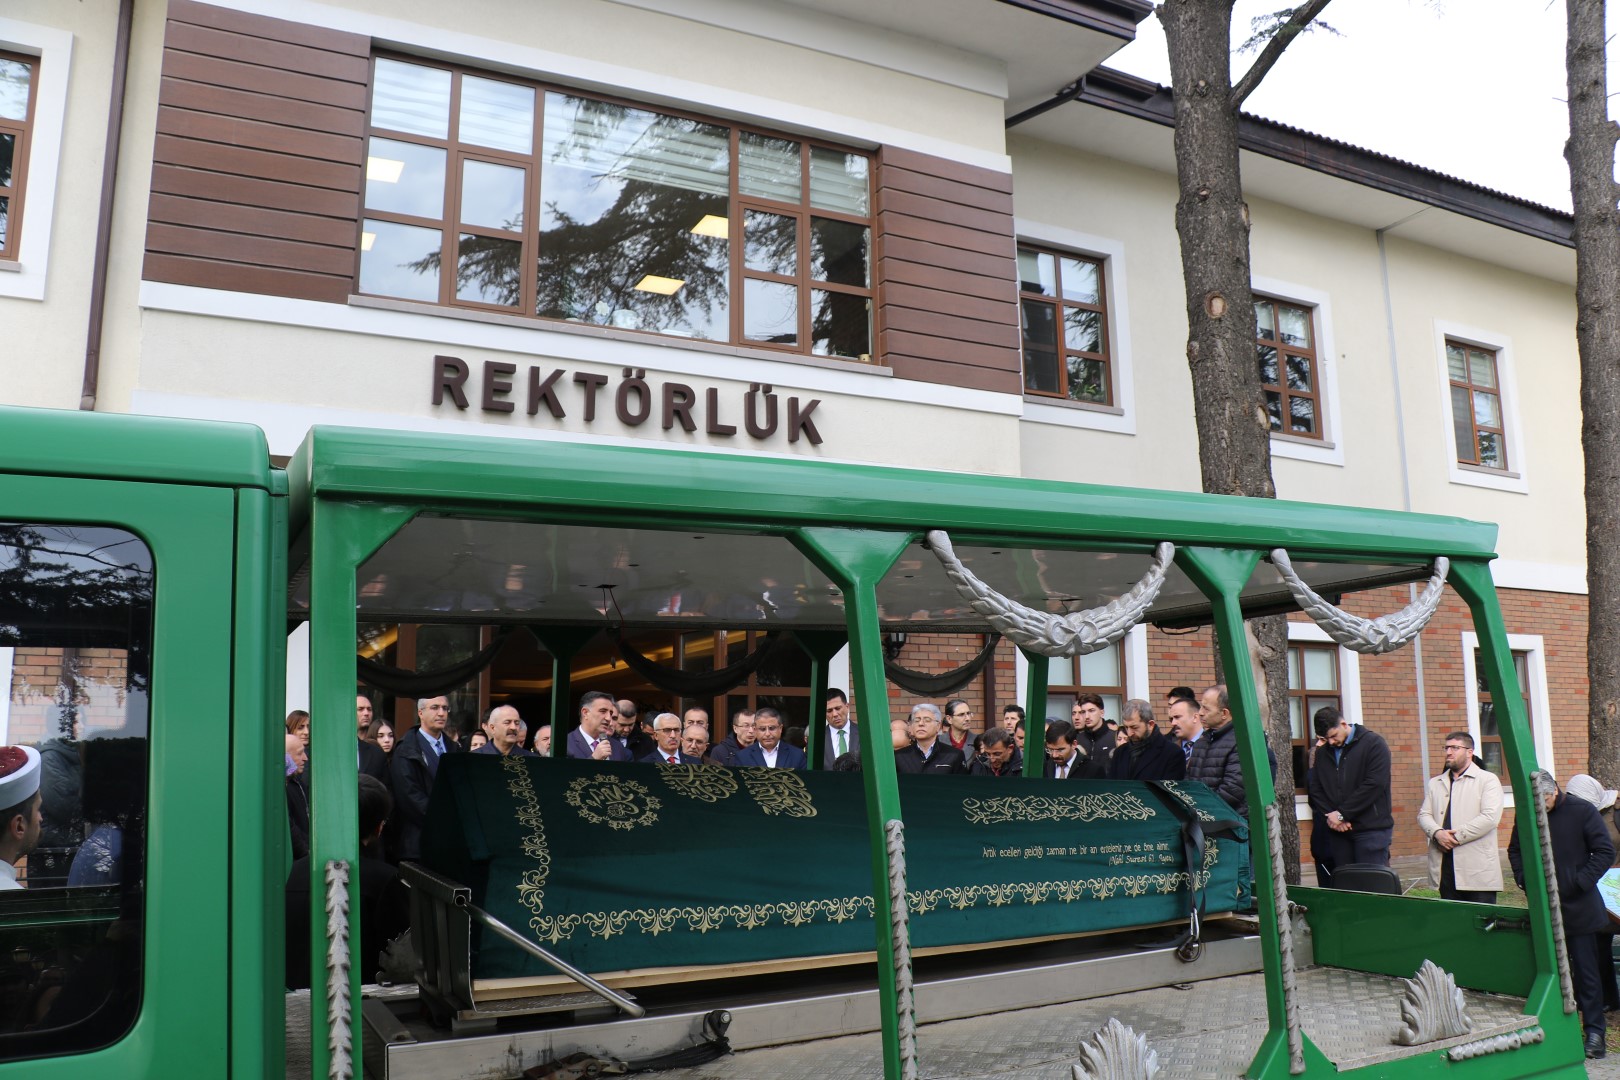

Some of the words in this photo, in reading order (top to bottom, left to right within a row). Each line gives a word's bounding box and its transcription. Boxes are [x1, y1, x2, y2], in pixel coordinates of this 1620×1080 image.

[431, 354, 823, 445] REKTÖRLÜK
[999, 846, 1021, 857] ecelleri
[1023, 845, 1044, 859] geldiği
[1046, 847, 1067, 856] zaman
[1069, 846, 1077, 855] ne
[1079, 844, 1087, 855] bir
[1090, 846, 1098, 854] an
[1133, 843, 1142, 852] de
[1143, 842, 1154, 852] öne
